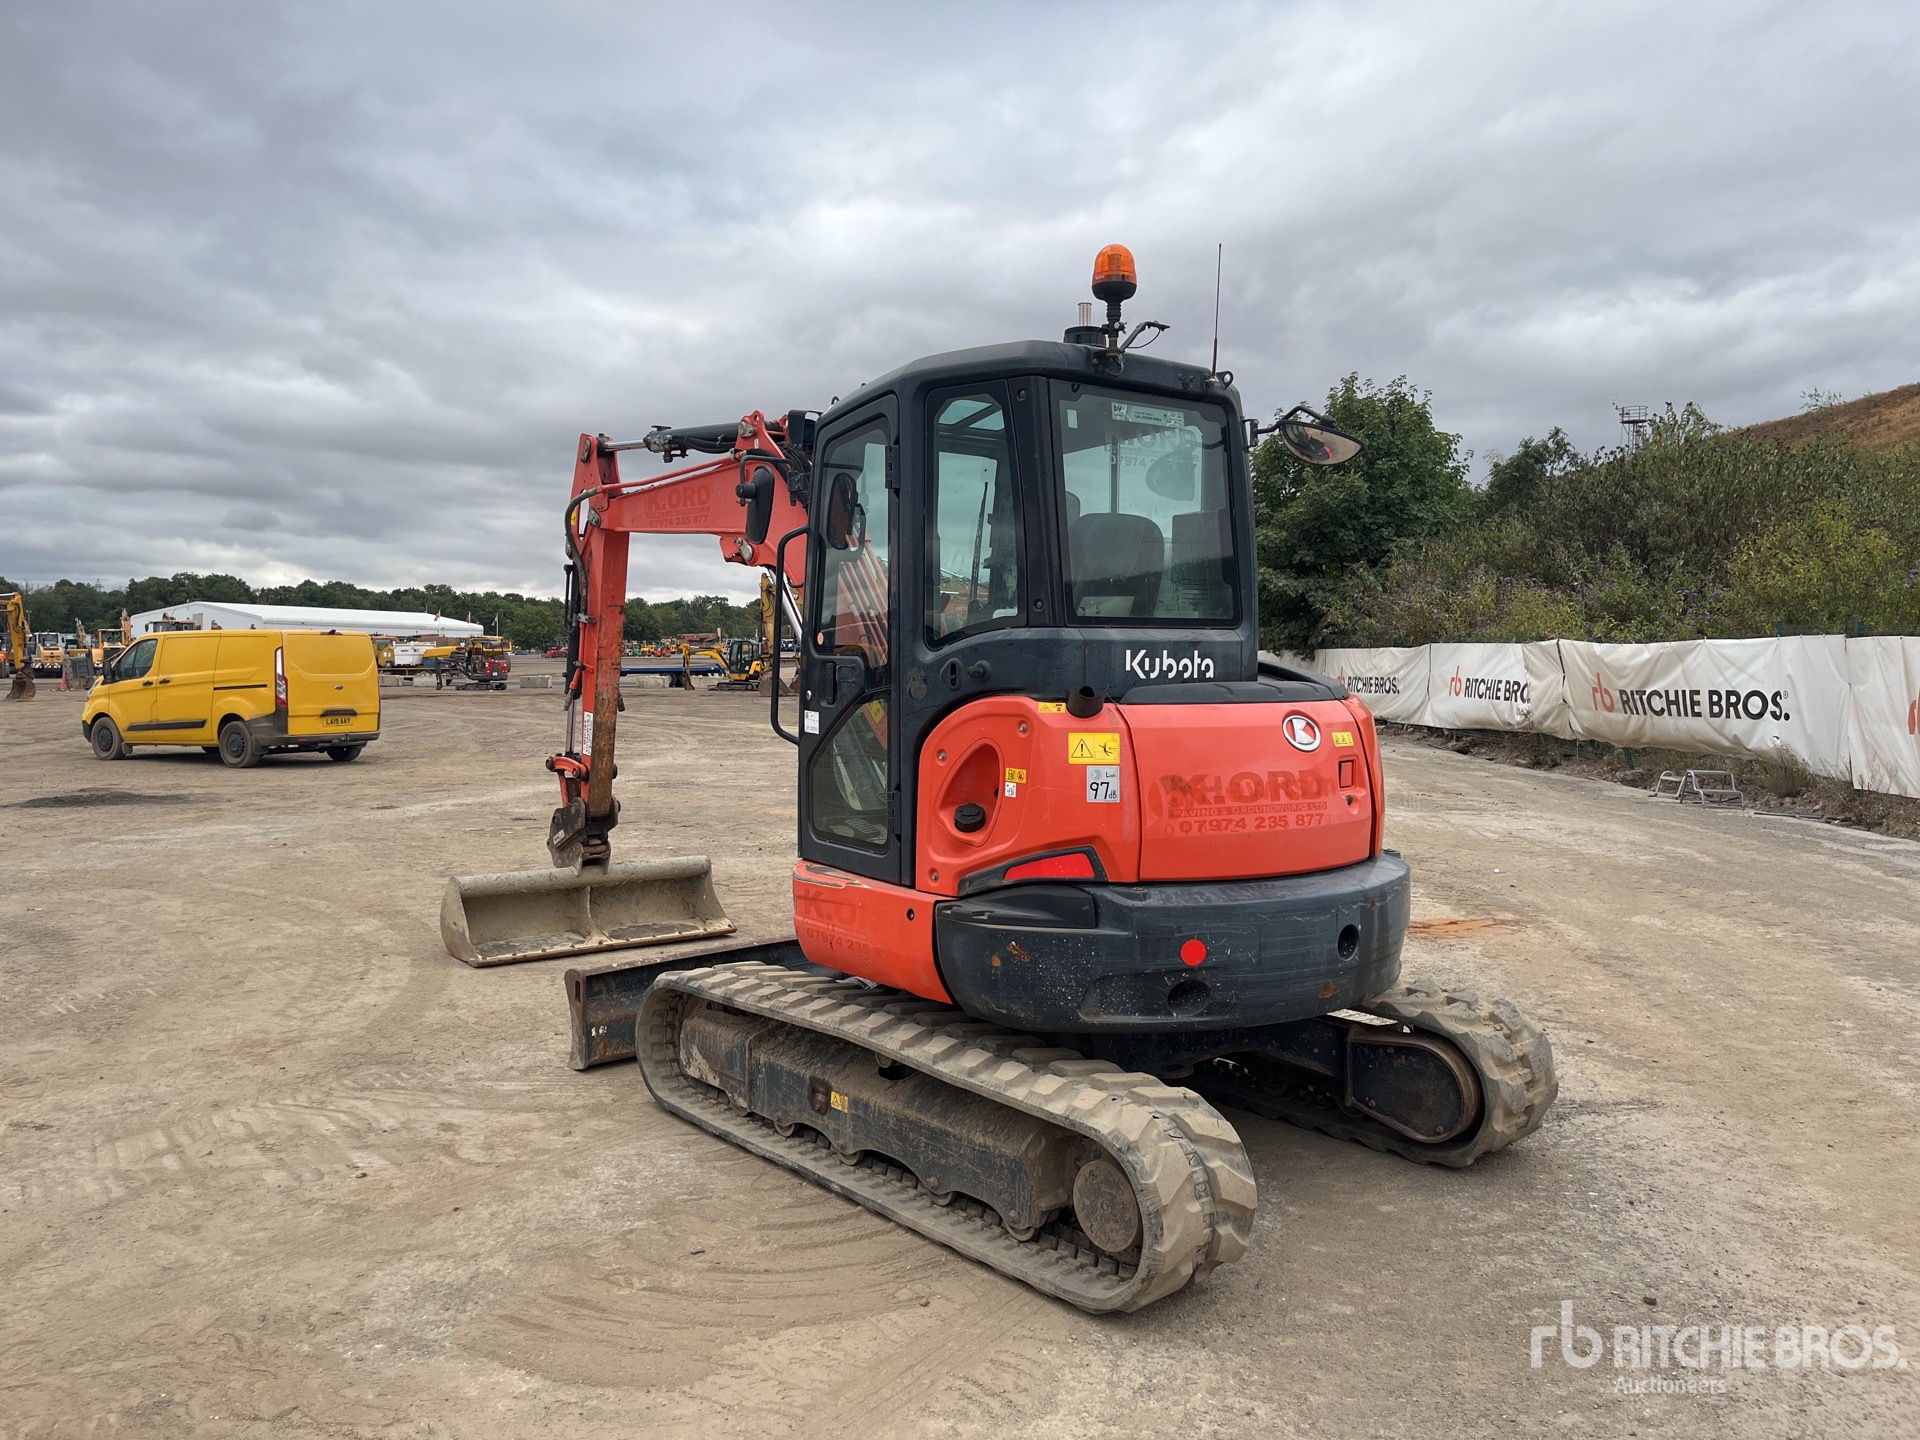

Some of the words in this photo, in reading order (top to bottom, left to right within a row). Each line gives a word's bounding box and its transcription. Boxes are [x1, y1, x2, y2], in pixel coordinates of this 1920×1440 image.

[648, 485, 710, 511] K.ORD
[676, 516, 690, 526] 235
[693, 514, 708, 524] 877
[1125, 649, 1214, 679] Kubota
[1347, 676, 1373, 694] RITCHIE
[1374, 676, 1400, 695] BROS.
[1448, 665, 1462, 697] rb
[1464, 677, 1503, 701] RITCHIE
[1591, 672, 1614, 713] rb
[1619, 689, 1703, 718] RITCHIE
[1707, 689, 1791, 721] BROS.
[1090, 781, 1110, 800] 97
[1174, 807, 1219, 819] PAVING
[1232, 803, 1309, 816] GROUNDWORKS
[1179, 817, 1248, 834] 07974
[1254, 815, 1289, 830] 235
[1295, 812, 1325, 827] 877
